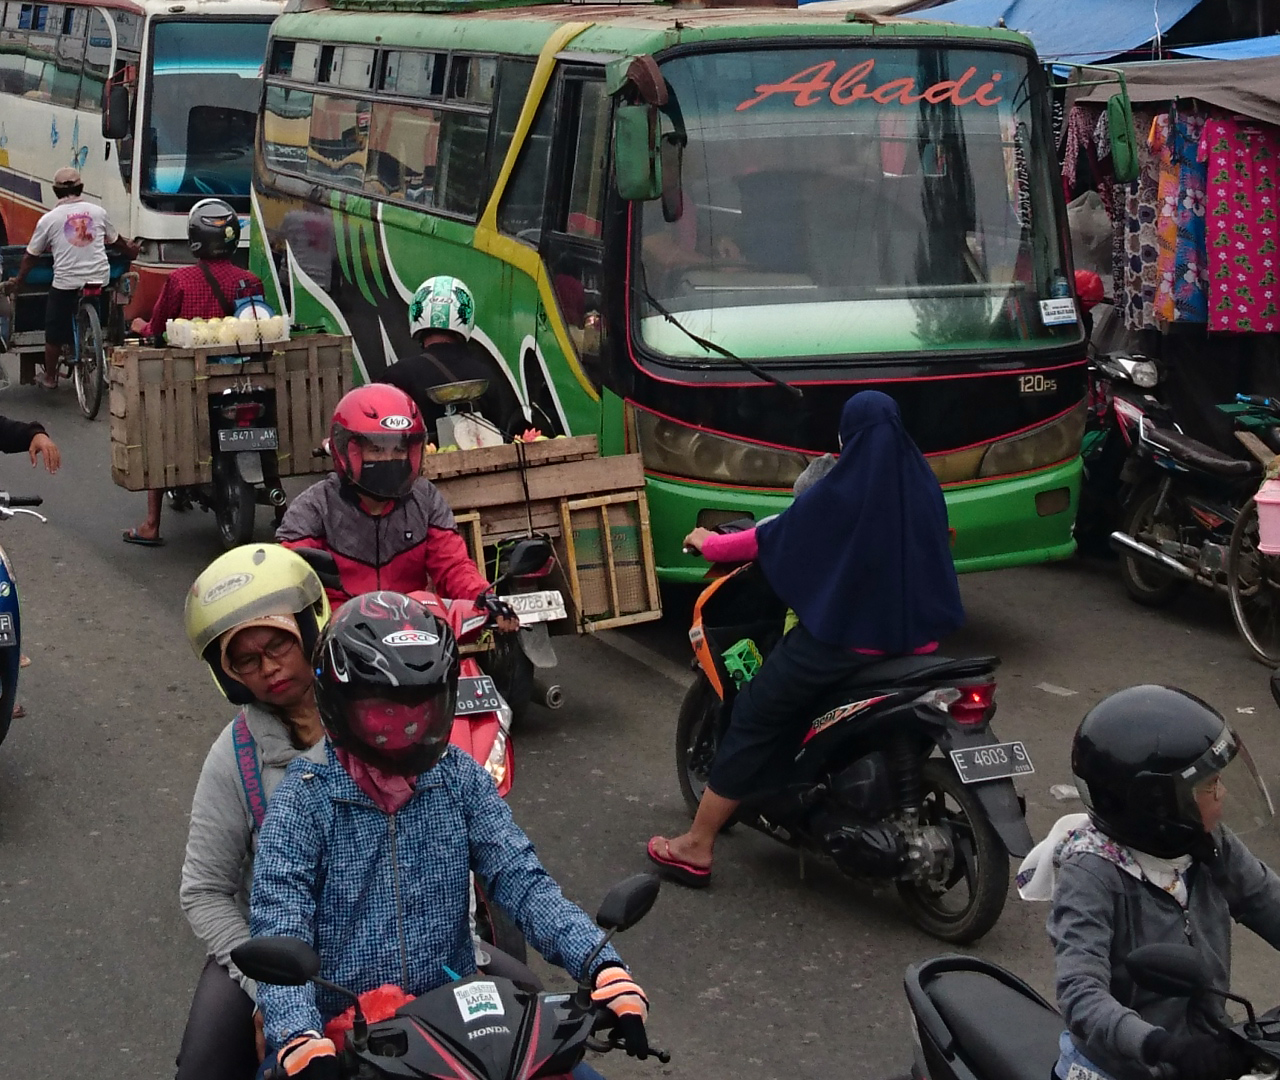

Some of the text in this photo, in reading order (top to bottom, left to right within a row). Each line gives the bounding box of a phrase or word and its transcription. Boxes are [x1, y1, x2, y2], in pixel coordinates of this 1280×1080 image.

[735, 58, 1003, 111] Abadi
[220, 432, 226, 441] E
[955, 745, 1026, 770] E 4603 S
[467, 1026, 511, 1040] HONDA
